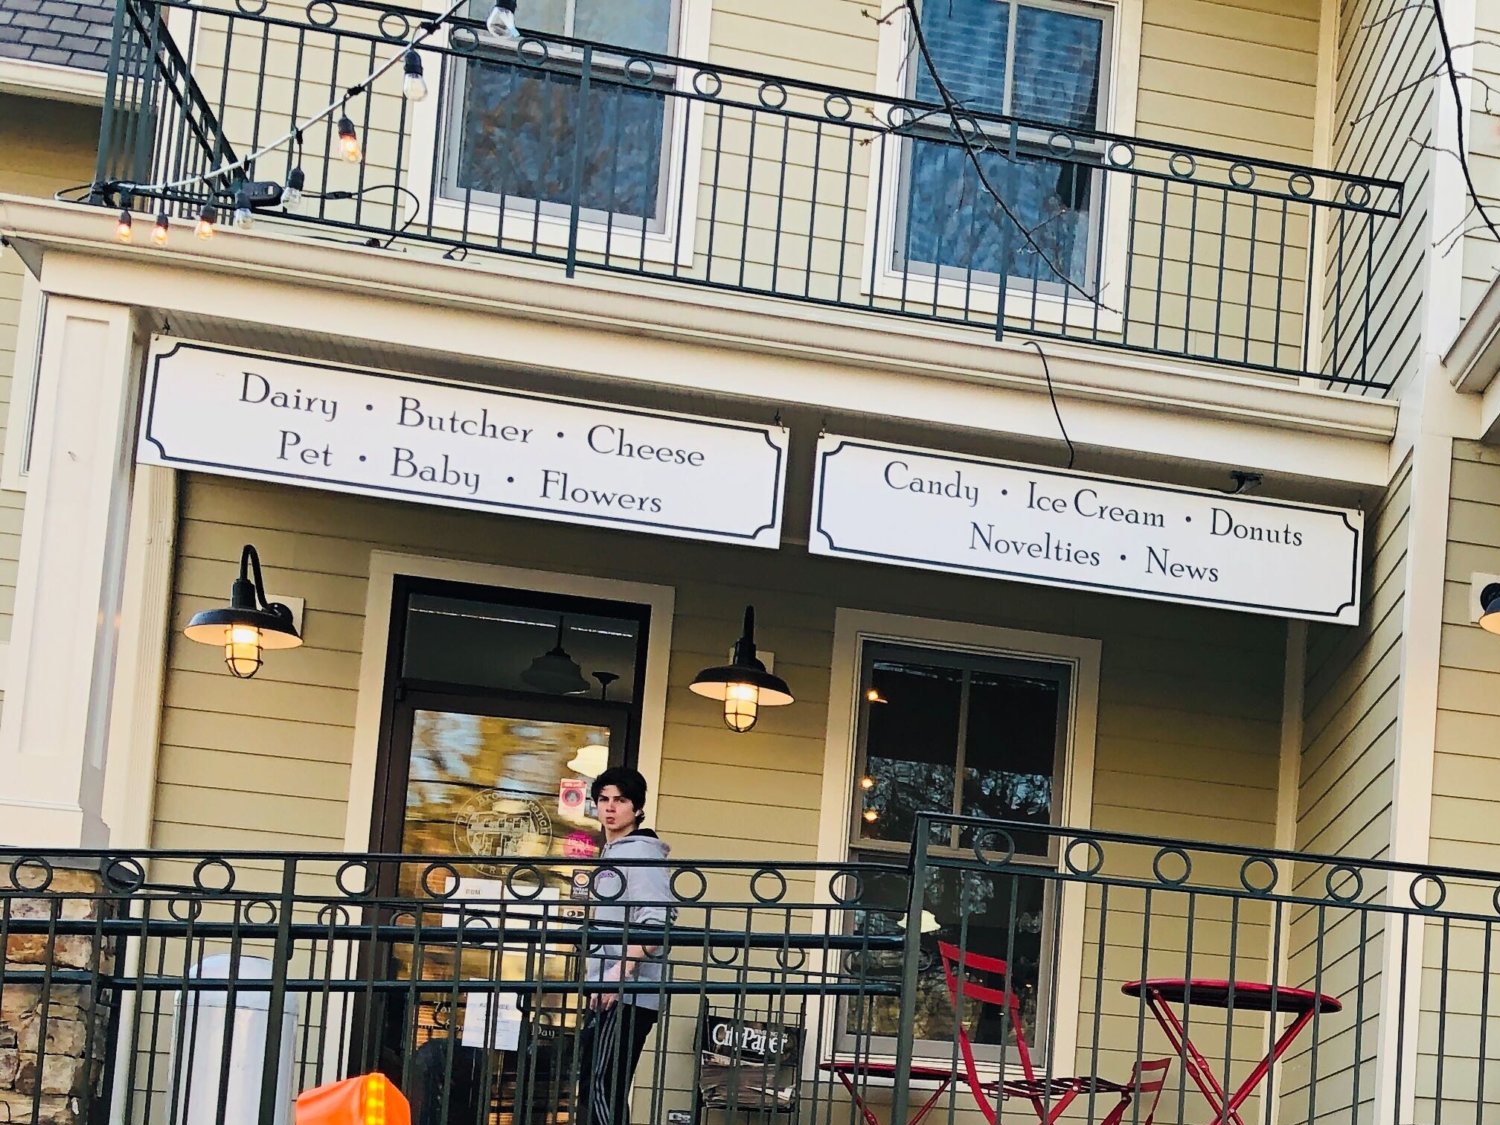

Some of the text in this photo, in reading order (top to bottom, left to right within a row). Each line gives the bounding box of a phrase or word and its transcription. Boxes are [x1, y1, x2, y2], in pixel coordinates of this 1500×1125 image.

[238, 371, 705, 468] Dairy Butcher Cheese
[276, 430, 663, 514] Pet Baby Flowers
[884, 460, 1304, 547] Candy Ice Cream Donuts
[968, 521, 1219, 583] Novelties News
